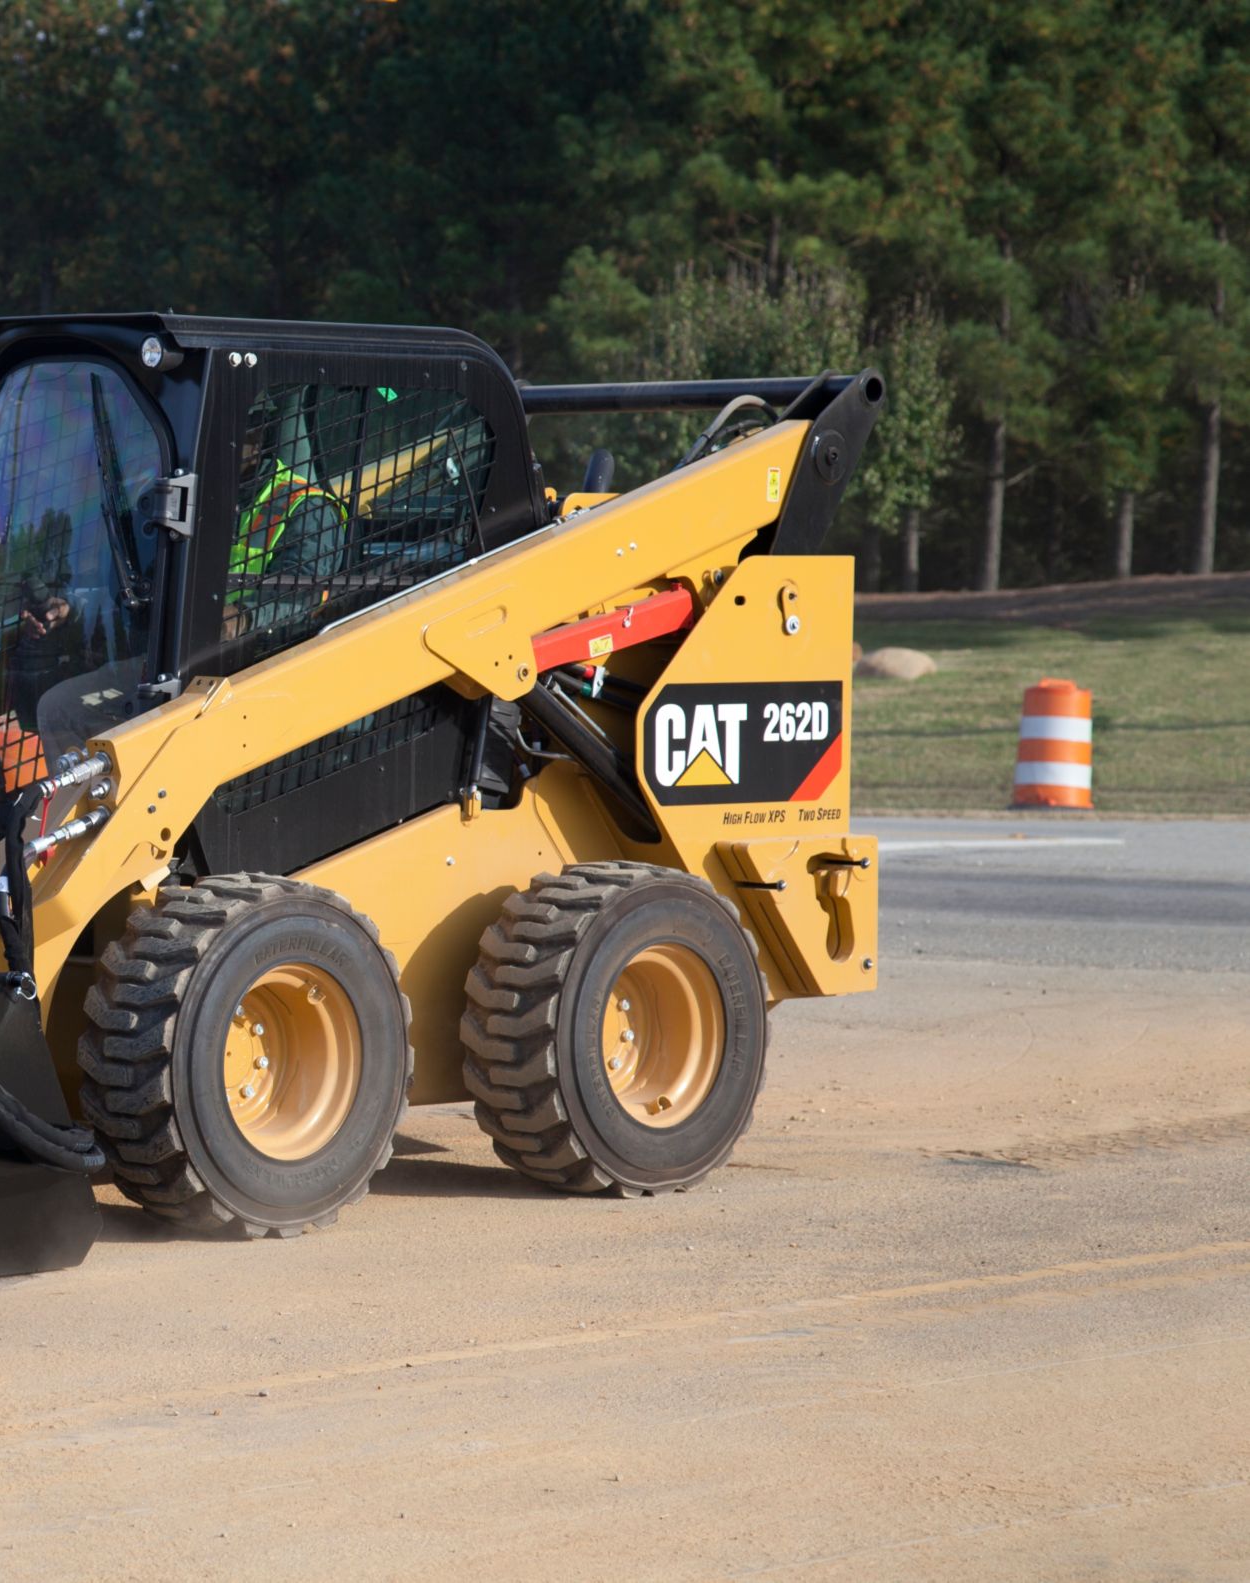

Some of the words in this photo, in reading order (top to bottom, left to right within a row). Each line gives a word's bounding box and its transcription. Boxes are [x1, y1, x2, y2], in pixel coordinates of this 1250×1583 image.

[655, 703, 748, 787] CAT
[763, 701, 829, 742] 262D
[768, 809, 786, 823] XPS
